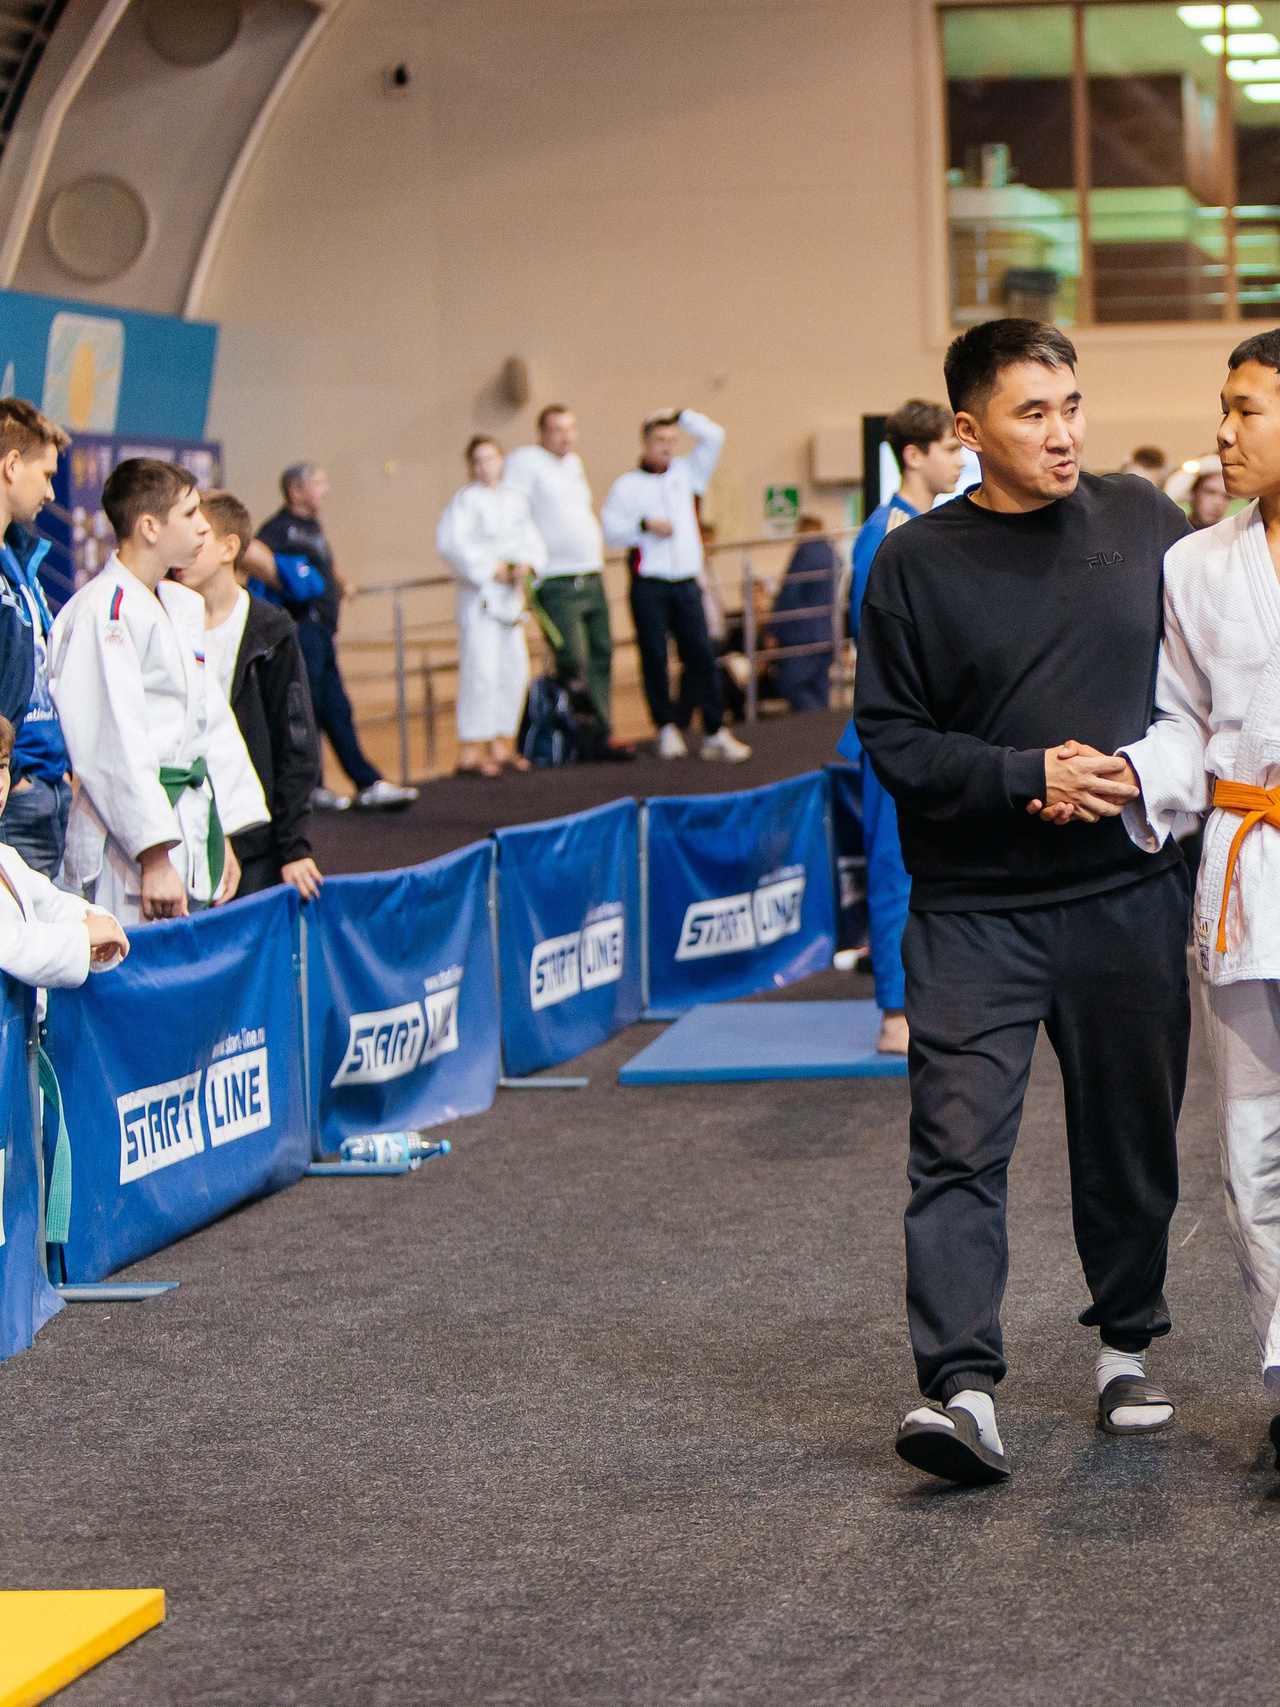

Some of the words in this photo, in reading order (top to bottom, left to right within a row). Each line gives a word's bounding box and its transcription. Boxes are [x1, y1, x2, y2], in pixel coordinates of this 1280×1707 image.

[1085, 551, 1124, 569] FILA
[535, 945, 576, 994] START
[584, 931, 618, 974] LINE
[345, 1017, 420, 1074] START
[123, 1086, 196, 1166] START
[210, 1066, 262, 1129] LINE
